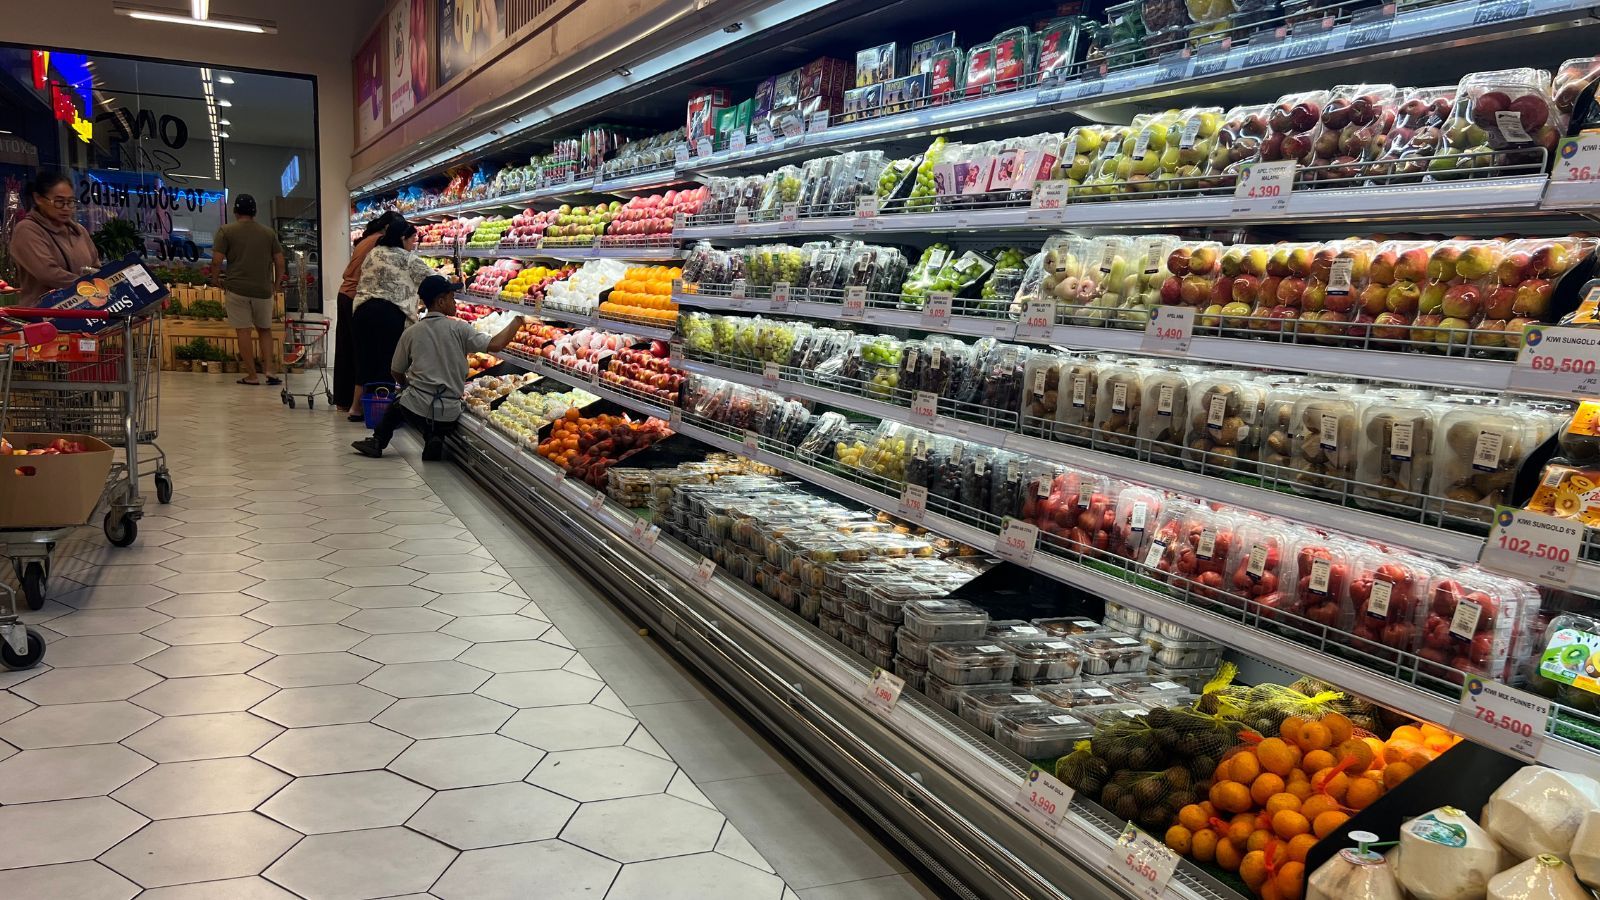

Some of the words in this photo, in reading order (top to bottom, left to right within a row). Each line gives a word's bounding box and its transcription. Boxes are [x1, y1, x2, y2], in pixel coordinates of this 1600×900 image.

[86, 294, 134, 328] Sunst
[1027, 317, 1047, 328] 4,050
[1156, 327, 1183, 340] 3,490
[1546, 335, 1561, 343] KIWI
[1562, 337, 1596, 346] SUNGOLD
[1531, 355, 1596, 375] 69,500
[1517, 518, 1531, 527] KIWI
[1532, 521, 1565, 533] SUNGOLD
[1499, 535, 1570, 563] 102,500
[1484, 687, 1497, 696] KIWI
[1510, 696, 1536, 710] PUNNET
[1474, 705, 1532, 738] 78,500
[1030, 791, 1056, 815] 3,990
[1125, 853, 1157, 882] 5,350
